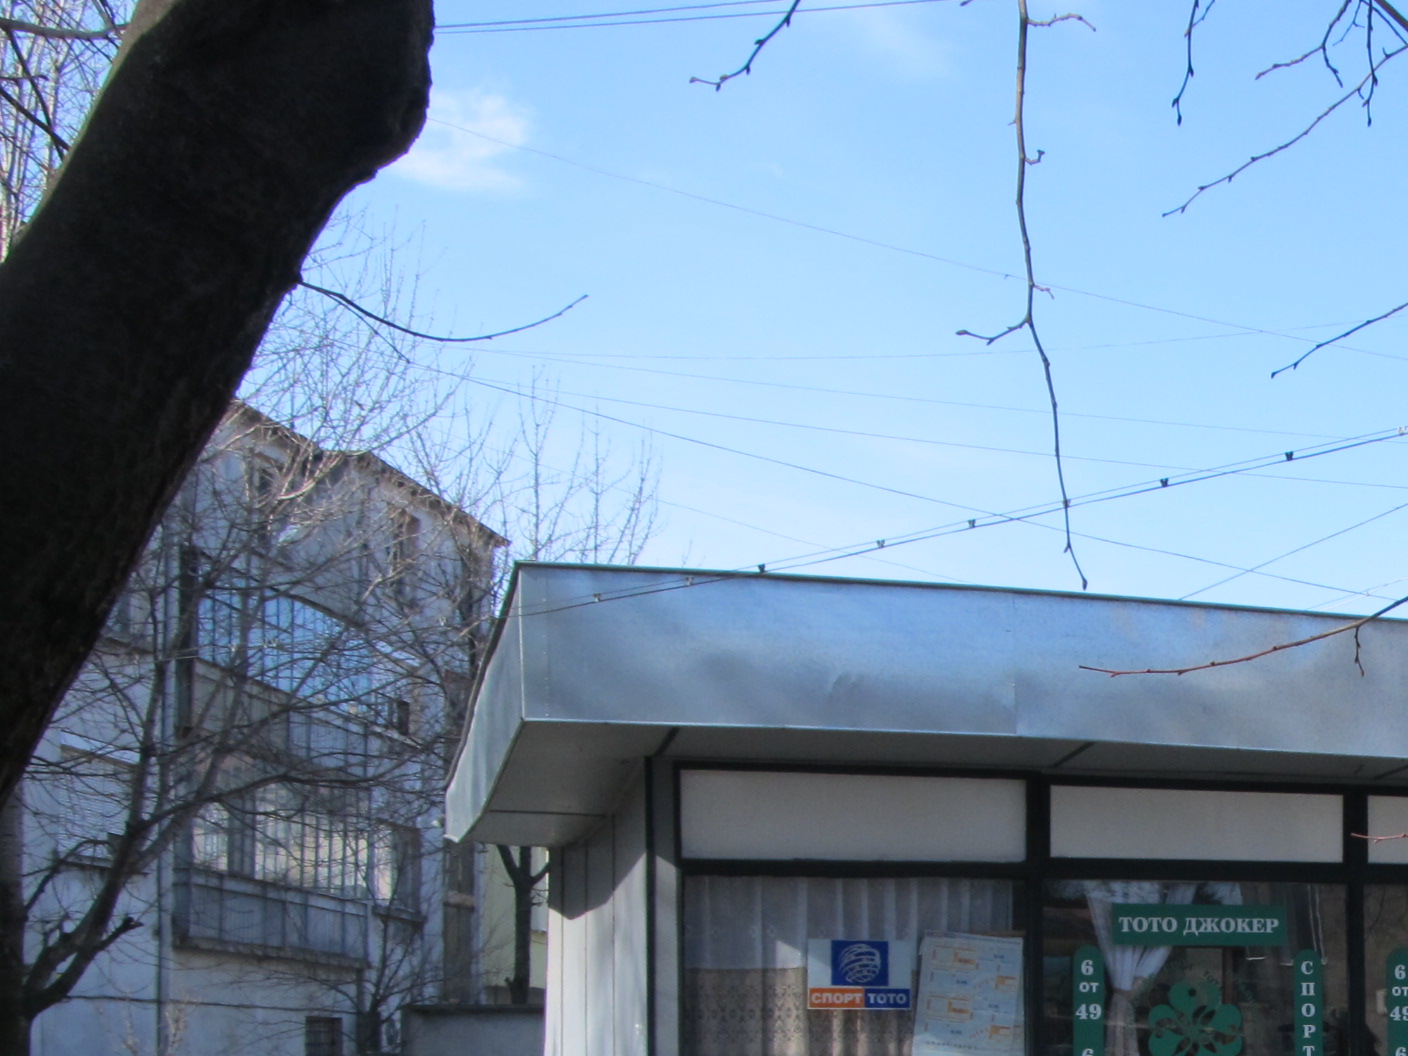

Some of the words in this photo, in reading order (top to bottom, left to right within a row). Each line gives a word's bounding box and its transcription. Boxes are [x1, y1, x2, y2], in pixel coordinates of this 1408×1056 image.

[1119, 917, 1177, 932] ТОТО
[1183, 918, 1279, 936] ДЖОКЕР
[1081, 960, 1093, 975] 6
[1395, 965, 1406, 979] 6
[1080, 982, 1099, 992] от
[1392, 987, 1408, 996] от
[811, 993, 863, 1003] СПОРТ
[868, 993, 906, 1003] ТОТО
[1076, 1004, 1101, 1019] 49
